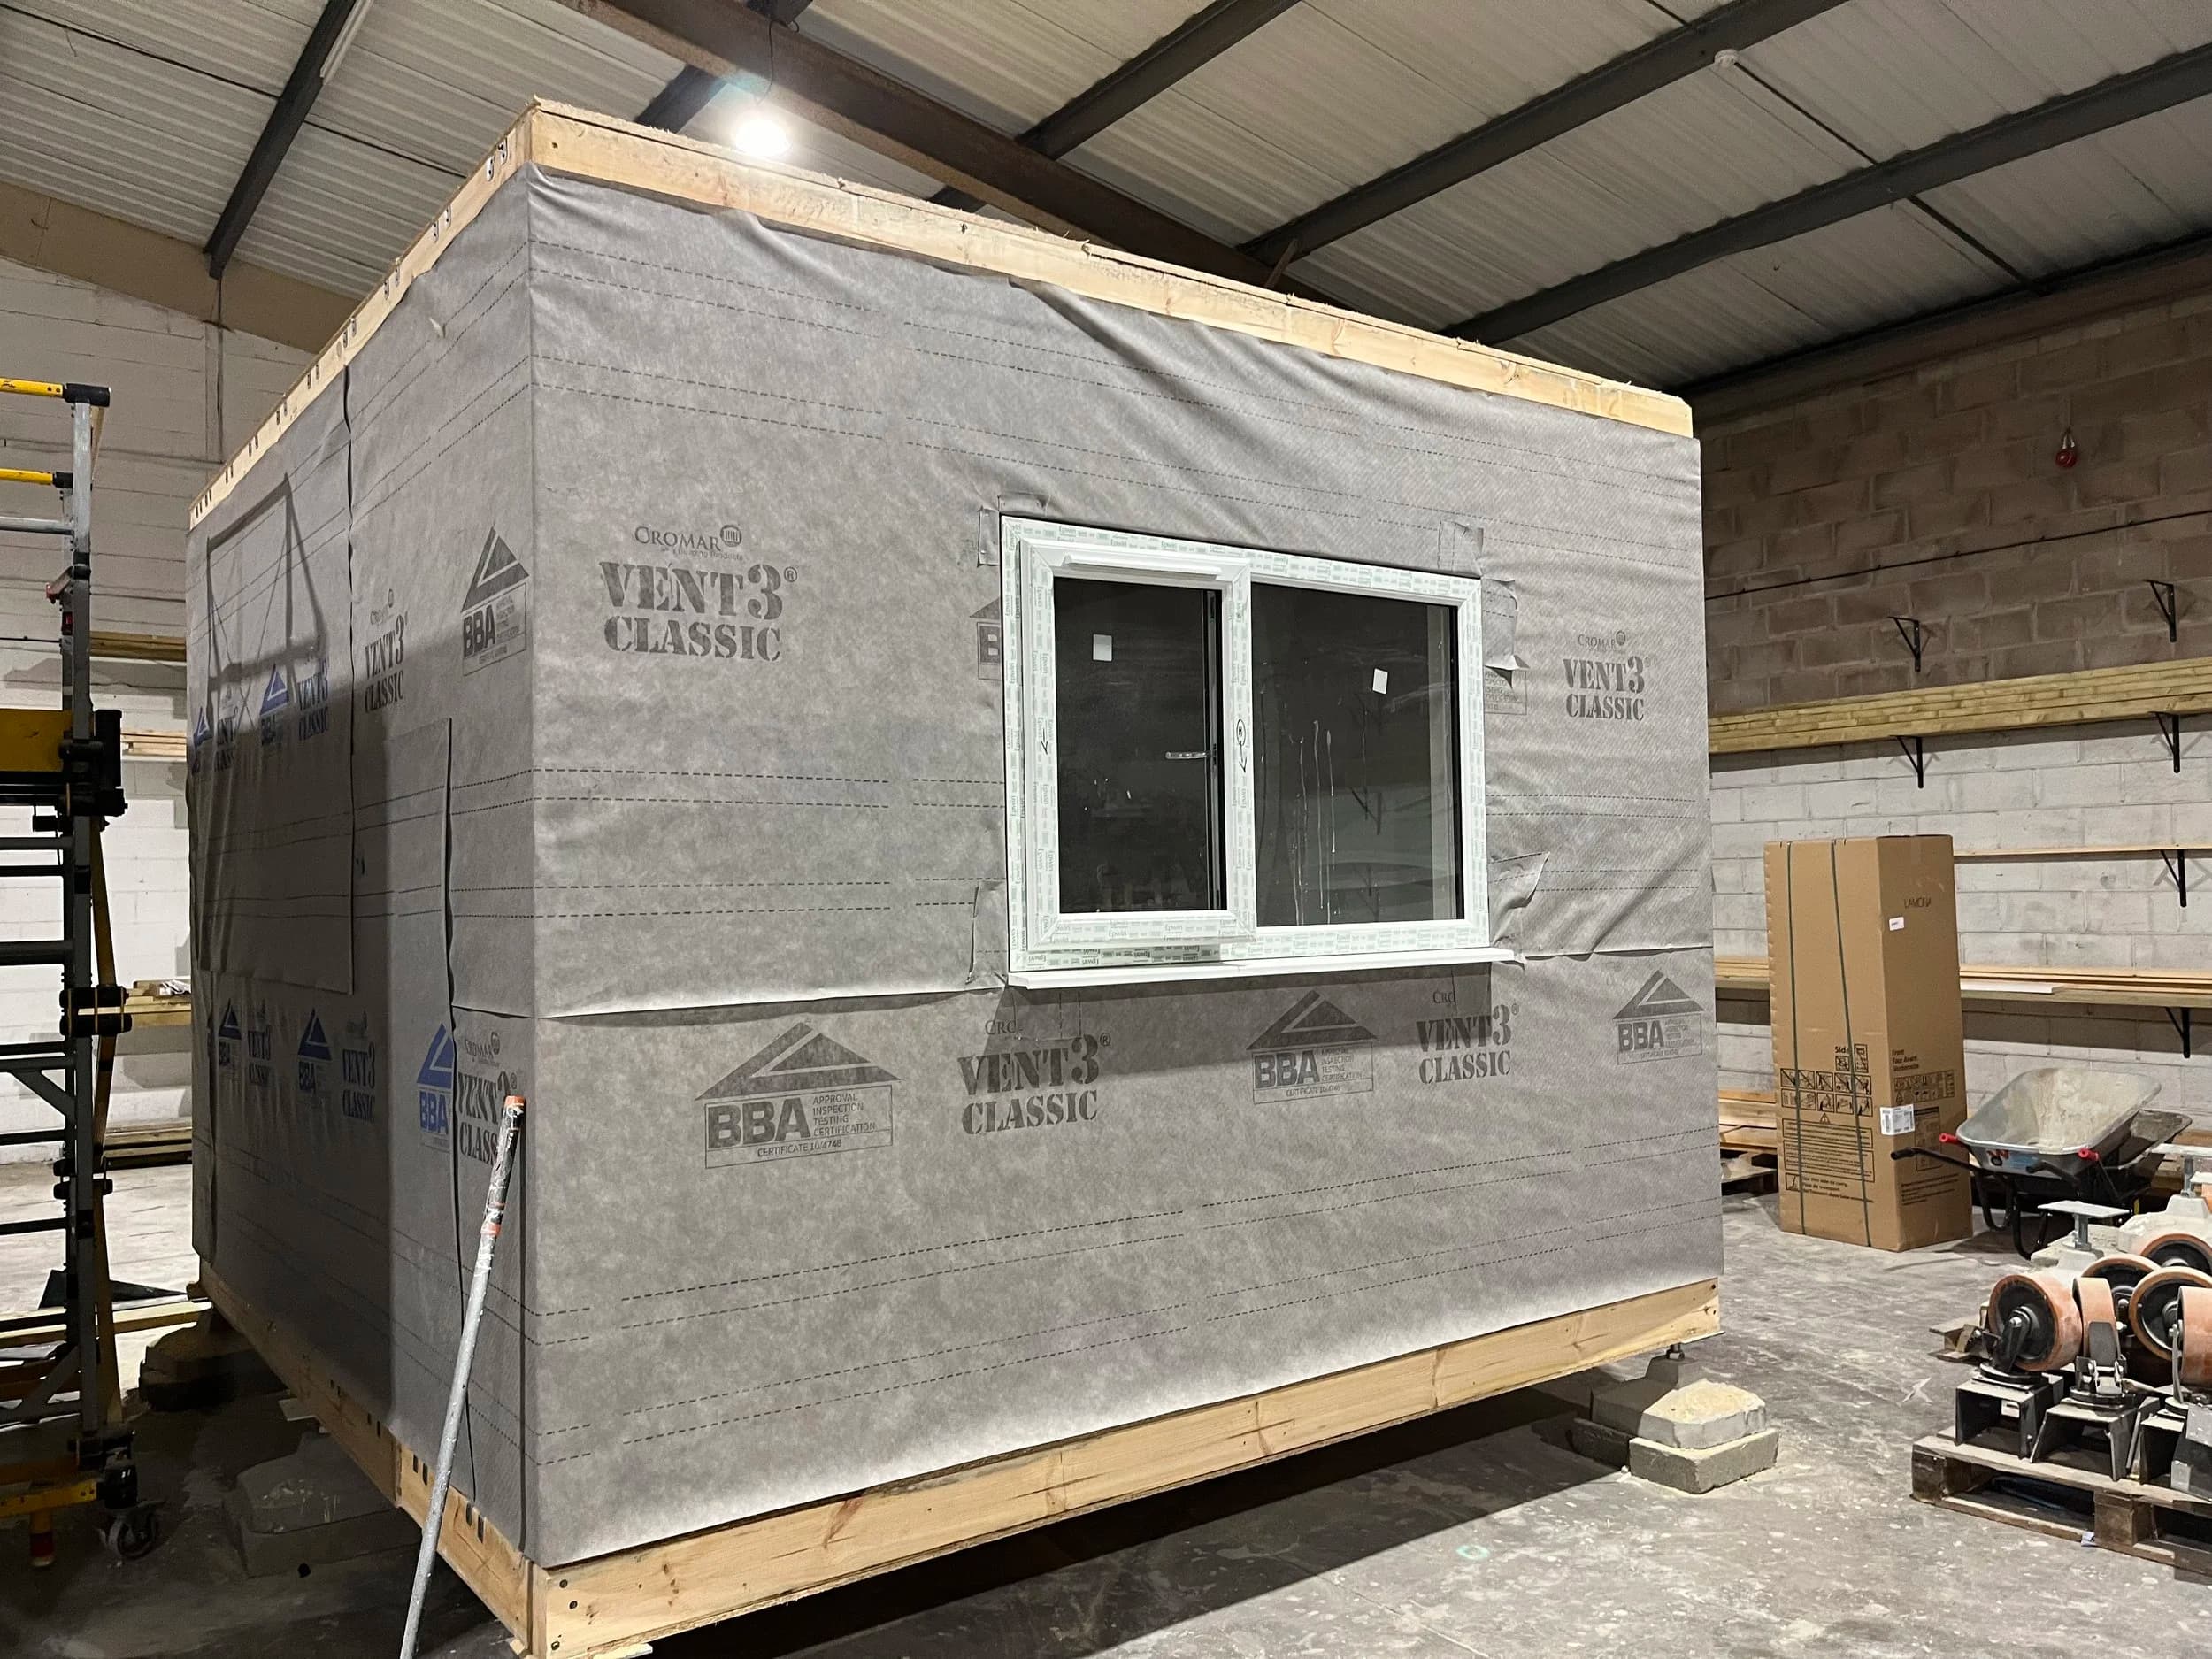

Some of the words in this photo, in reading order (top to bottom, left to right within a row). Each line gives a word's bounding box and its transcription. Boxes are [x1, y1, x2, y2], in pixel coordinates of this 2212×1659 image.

[634, 526, 720, 552] CROMAR
[599, 562, 783, 620] VENT3
[365, 614, 404, 680] VENT3
[463, 604, 495, 658] BBA
[604, 616, 780, 662] CLASSIC
[365, 670, 404, 714] CLASSIC
[1563, 656, 1645, 694] VENT3
[1565, 693, 1645, 721] CLASSIC
[1433, 991, 1455, 1005] CRO
[985, 1020, 1018, 1035] CRO
[1416, 1004, 1512, 1052] VENT3
[1618, 1020, 1664, 1052] BBA
[958, 1033, 1099, 1095] VENT3
[1255, 1050, 1320, 1089] BBA
[1419, 1051, 1511, 1085] CLASSIC
[419, 1090, 449, 1135] BBA
[813, 1093, 857, 1105] APPROVAL
[813, 1102, 864, 1116] INSPECTION
[962, 1090, 1098, 1134] CLASSIC
[708, 1097, 811, 1148] BBA
[813, 1114, 849, 1126] TESTING
[813, 1122, 876, 1136] CERTIFICATION
[459, 1121, 498, 1166] CLASS
[757, 1142, 809, 1157] CERTIFICATE
